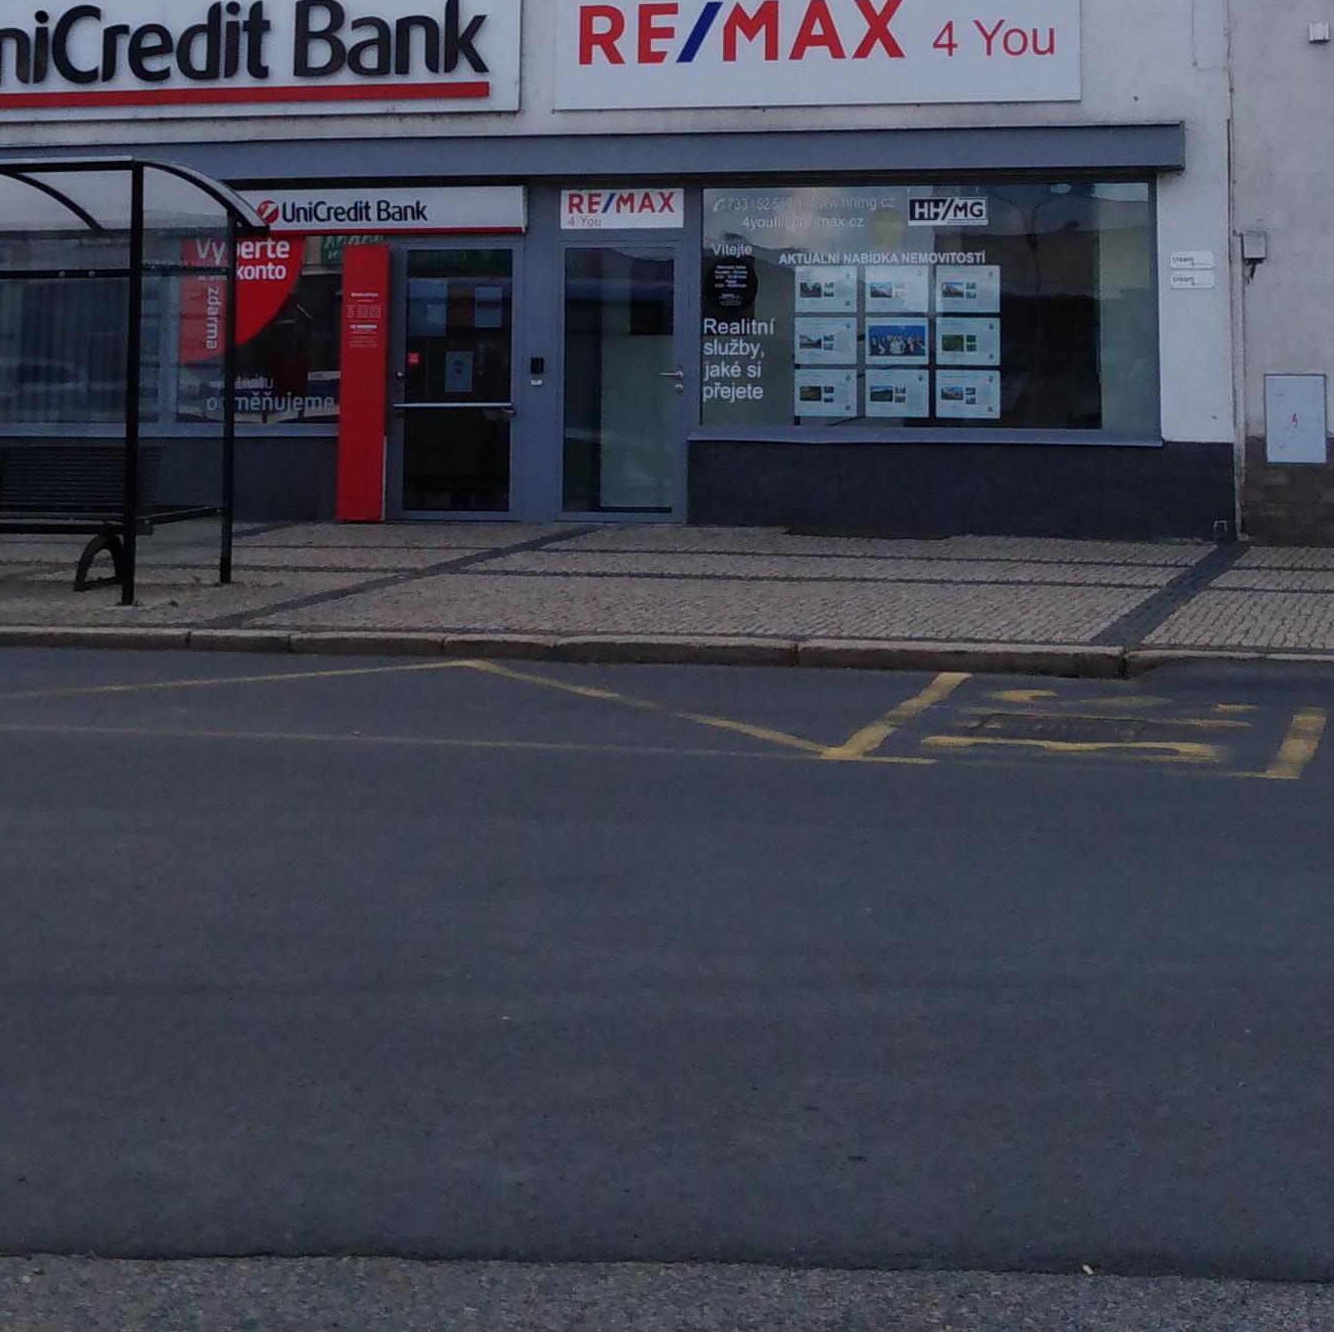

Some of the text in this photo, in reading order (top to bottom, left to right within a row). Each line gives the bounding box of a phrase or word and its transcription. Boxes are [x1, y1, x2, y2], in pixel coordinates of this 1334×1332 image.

[932, 20, 958, 58] 4
[972, 18, 1057, 57] You
[282, 199, 428, 224] UniCredit Bank
[567, 191, 676, 214] RE/MAX
[915, 198, 984, 220] HH/MG
[567, 216, 602, 227] 4 You
[712, 244, 753, 257] Vítejte
[779, 250, 986, 266] AKTUÁLNÍ NABÍDKA NEMOVITOSTÍ
[235, 262, 288, 280] konto
[205, 287, 224, 350] zdarma
[703, 318, 775, 335] Realitní
[703, 338, 765, 359] služby,
[704, 361, 762, 381] jaké si
[703, 382, 764, 403] přejete
